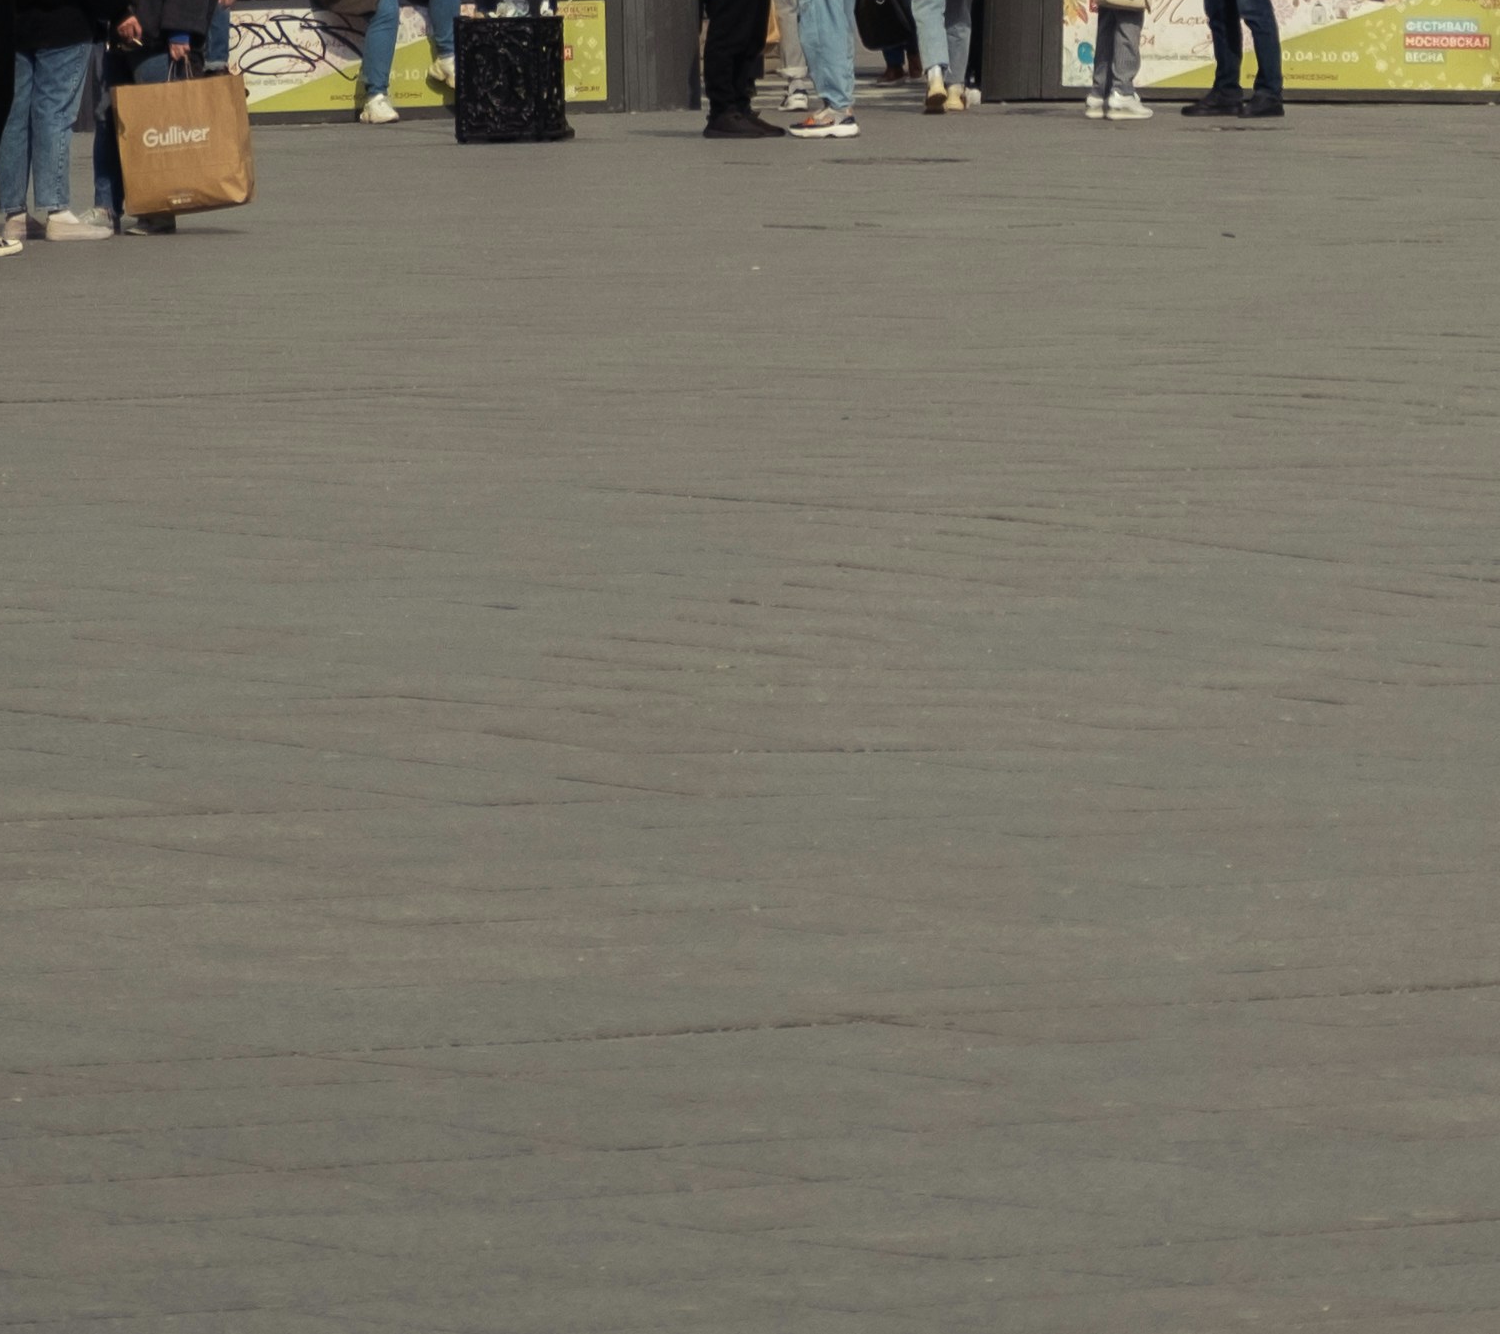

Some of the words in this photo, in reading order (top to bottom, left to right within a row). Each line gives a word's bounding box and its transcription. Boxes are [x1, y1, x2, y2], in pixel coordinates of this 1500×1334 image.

[1405, 20, 1478, 33] ФЕСТИВАЛЬ
[1405, 35, 1490, 48] МОСКОВСКАЯ
[1405, 51, 1445, 64] ВЕСНА
[143, 126, 211, 148] Gulliver
